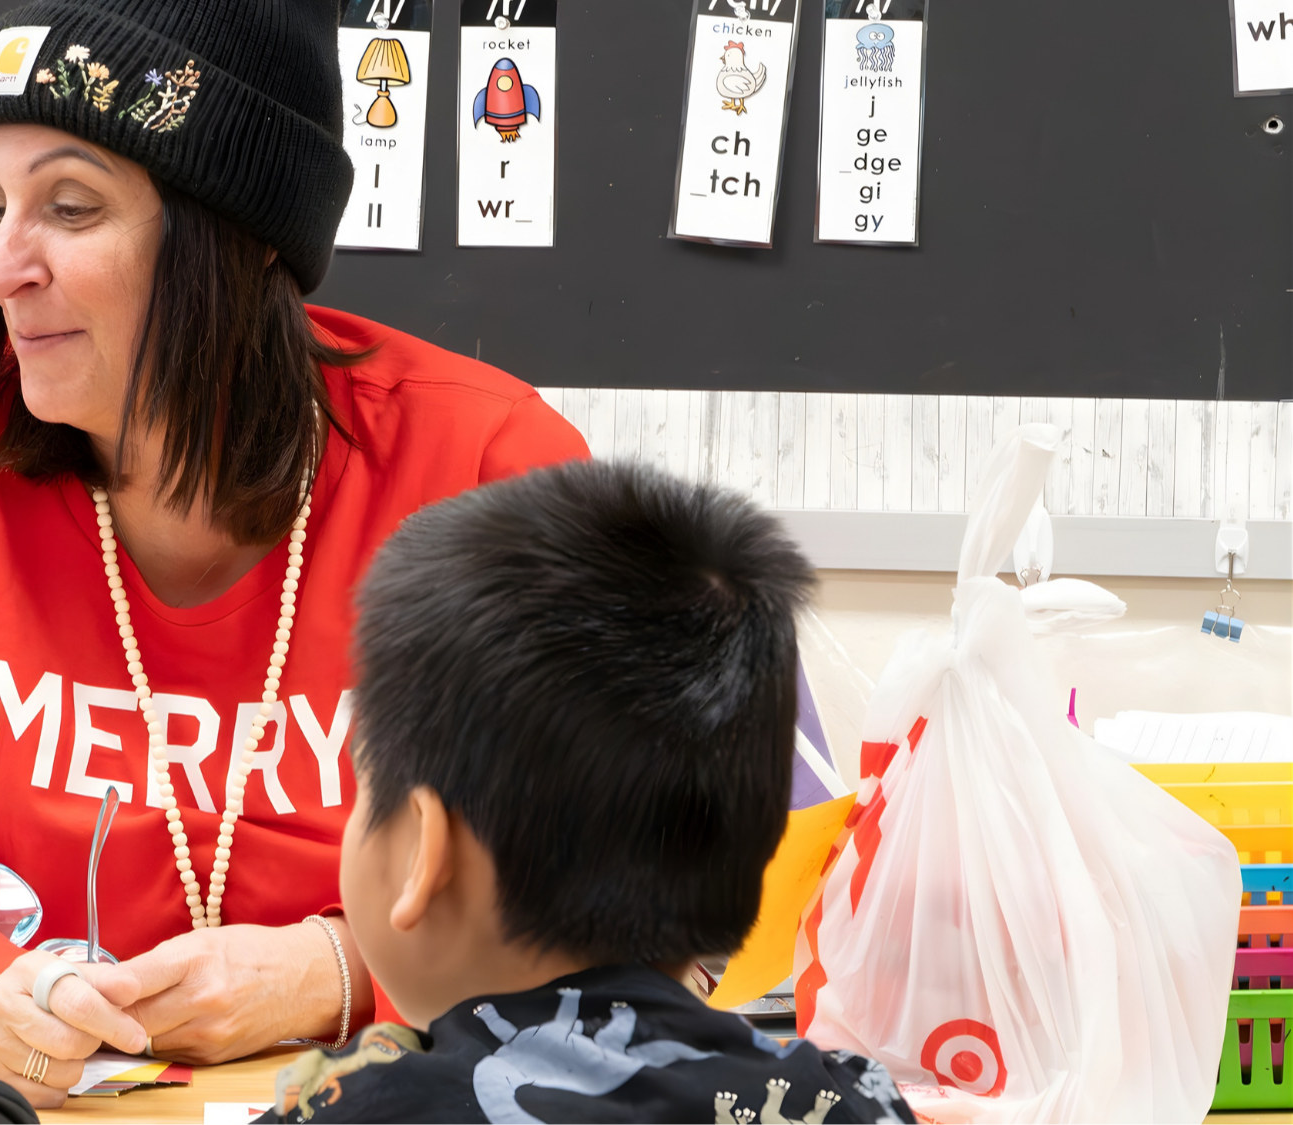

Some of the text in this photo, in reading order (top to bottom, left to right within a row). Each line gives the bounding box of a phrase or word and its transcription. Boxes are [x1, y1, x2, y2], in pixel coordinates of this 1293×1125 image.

[712, 22, 772, 38] chicken
[482, 38, 530, 50] rocket
[844, 75, 903, 89] jellyfish
[869, 95, 876, 118] j
[360, 135, 397, 150] lamp
[711, 131, 751, 156] ch
[856, 128, 888, 147] ge
[500, 160, 510, 179] r
[859, 182, 882, 204] gi
[854, 213, 884, 233] gy
